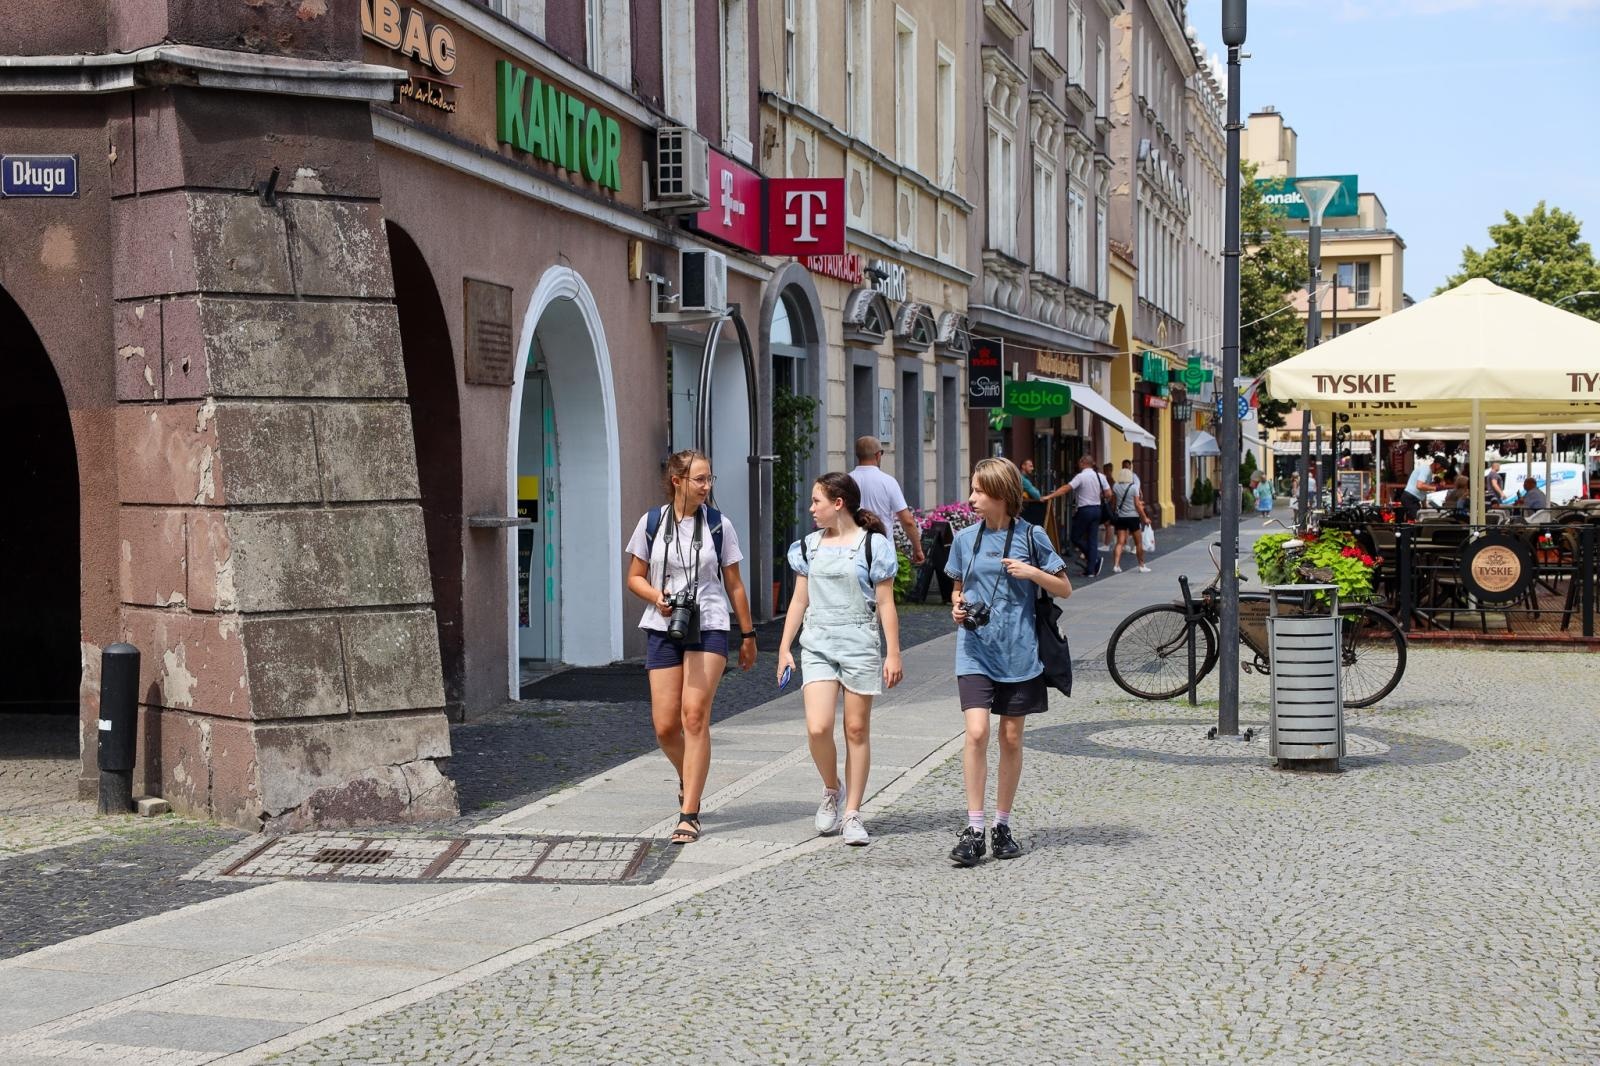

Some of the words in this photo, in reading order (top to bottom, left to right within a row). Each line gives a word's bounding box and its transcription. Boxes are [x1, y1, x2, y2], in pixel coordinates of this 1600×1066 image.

[400, 77, 414, 104] pod
[497, 59, 621, 192] KANTOR
[12, 160, 66, 192] Długa
[1312, 373, 1397, 394] TYSKIE
[1566, 372, 1600, 393] TY
[1009, 389, 1064, 406] żabka
[1478, 566, 1514, 576] TYSKIE
